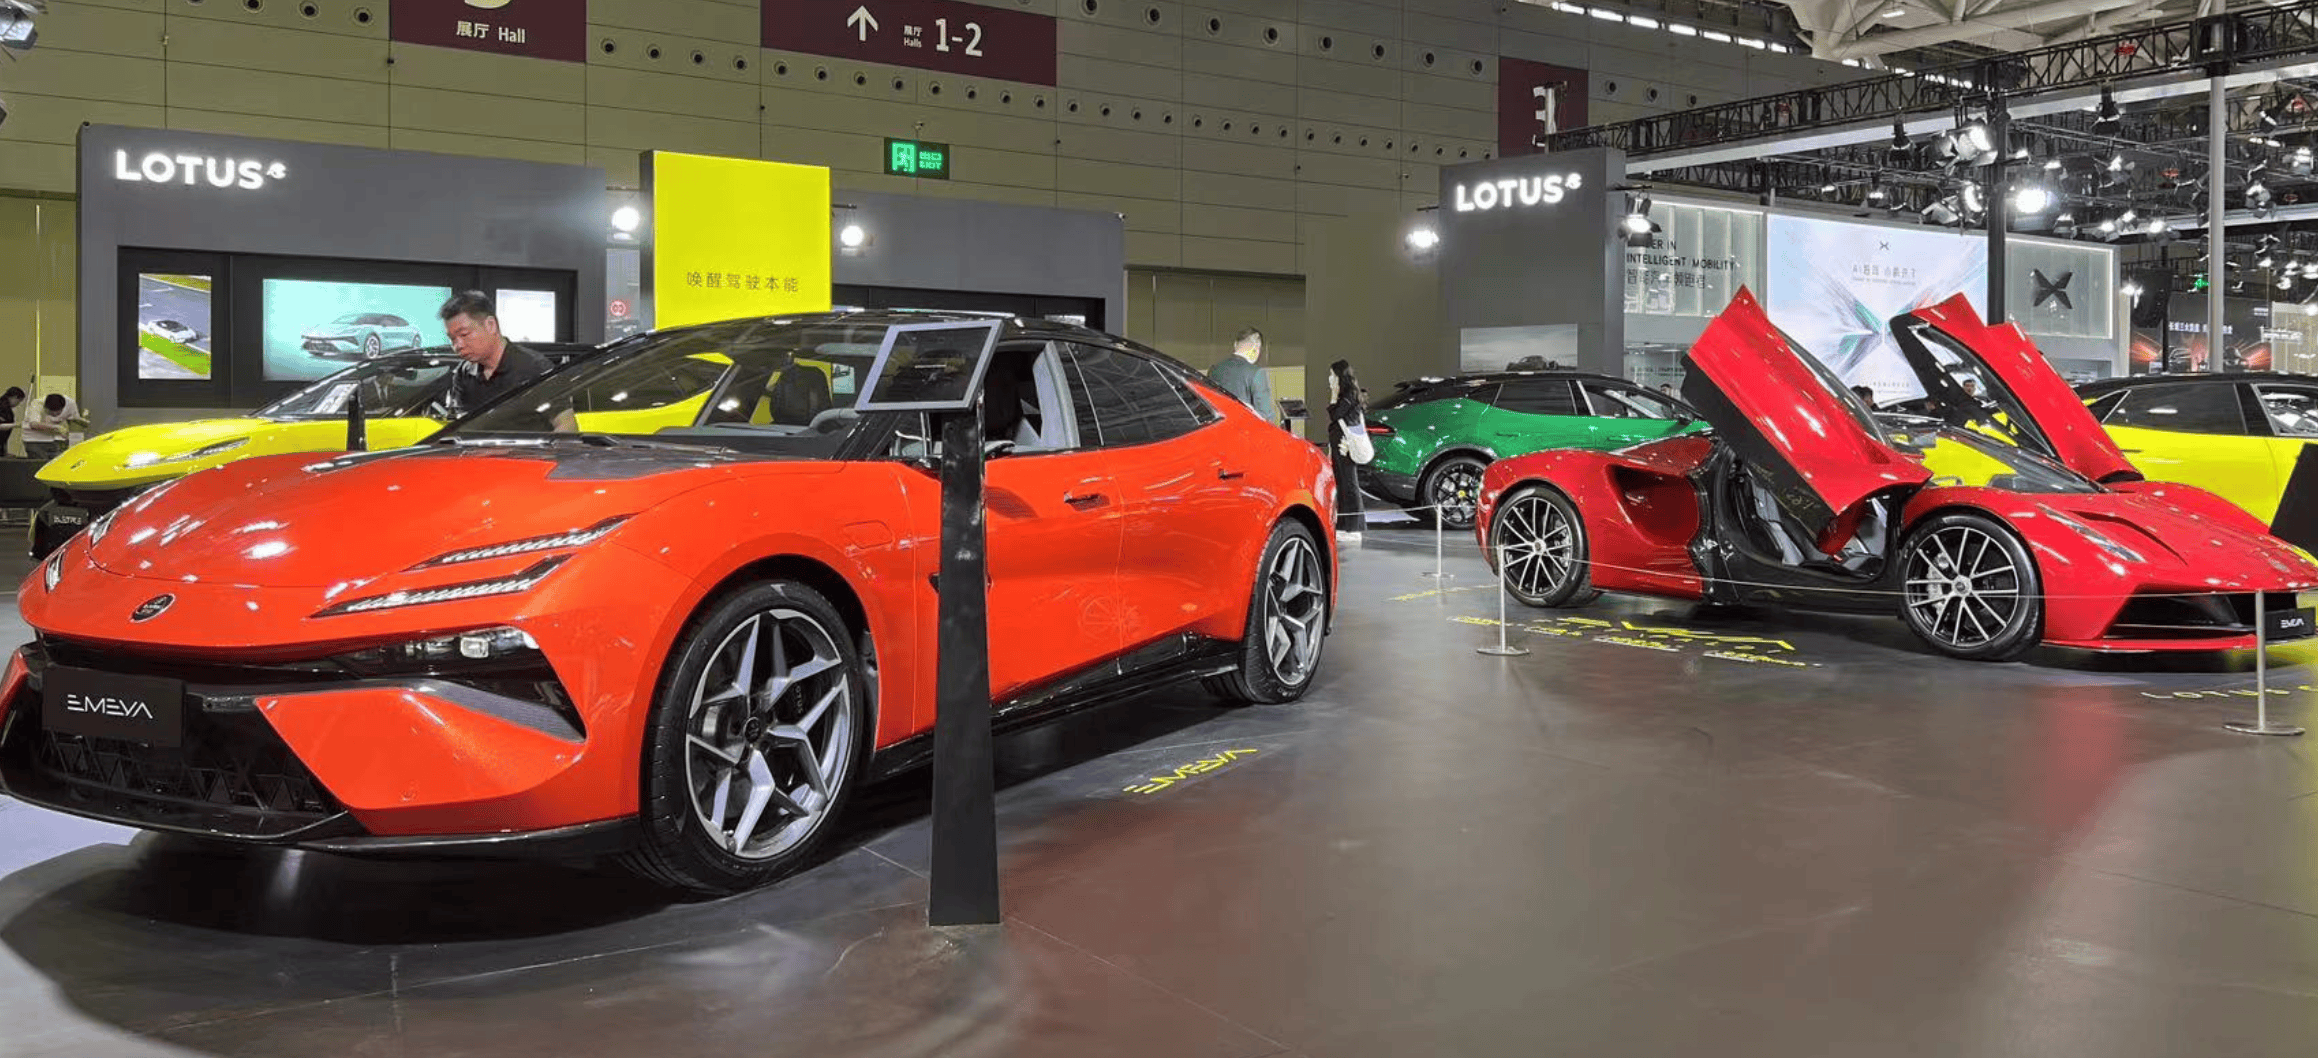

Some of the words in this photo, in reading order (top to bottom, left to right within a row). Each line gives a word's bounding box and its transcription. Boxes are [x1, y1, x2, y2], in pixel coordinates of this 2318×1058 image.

[456, 20, 490, 39] 展厅
[498, 27, 525, 43] Hall
[936, 18, 982, 57] 1-2
[903, 37, 922, 48] Halls
[919, 151, 942, 161] 出口
[115, 149, 264, 190] LOTUS
[1456, 174, 1564, 212] LOTUS
[1626, 253, 1687, 268] INTELLIGENT
[1692, 258, 1736, 271] MOBILITY
[686, 271, 799, 293] 唤醒驾驶本能
[67, 694, 154, 719] EMEYA
